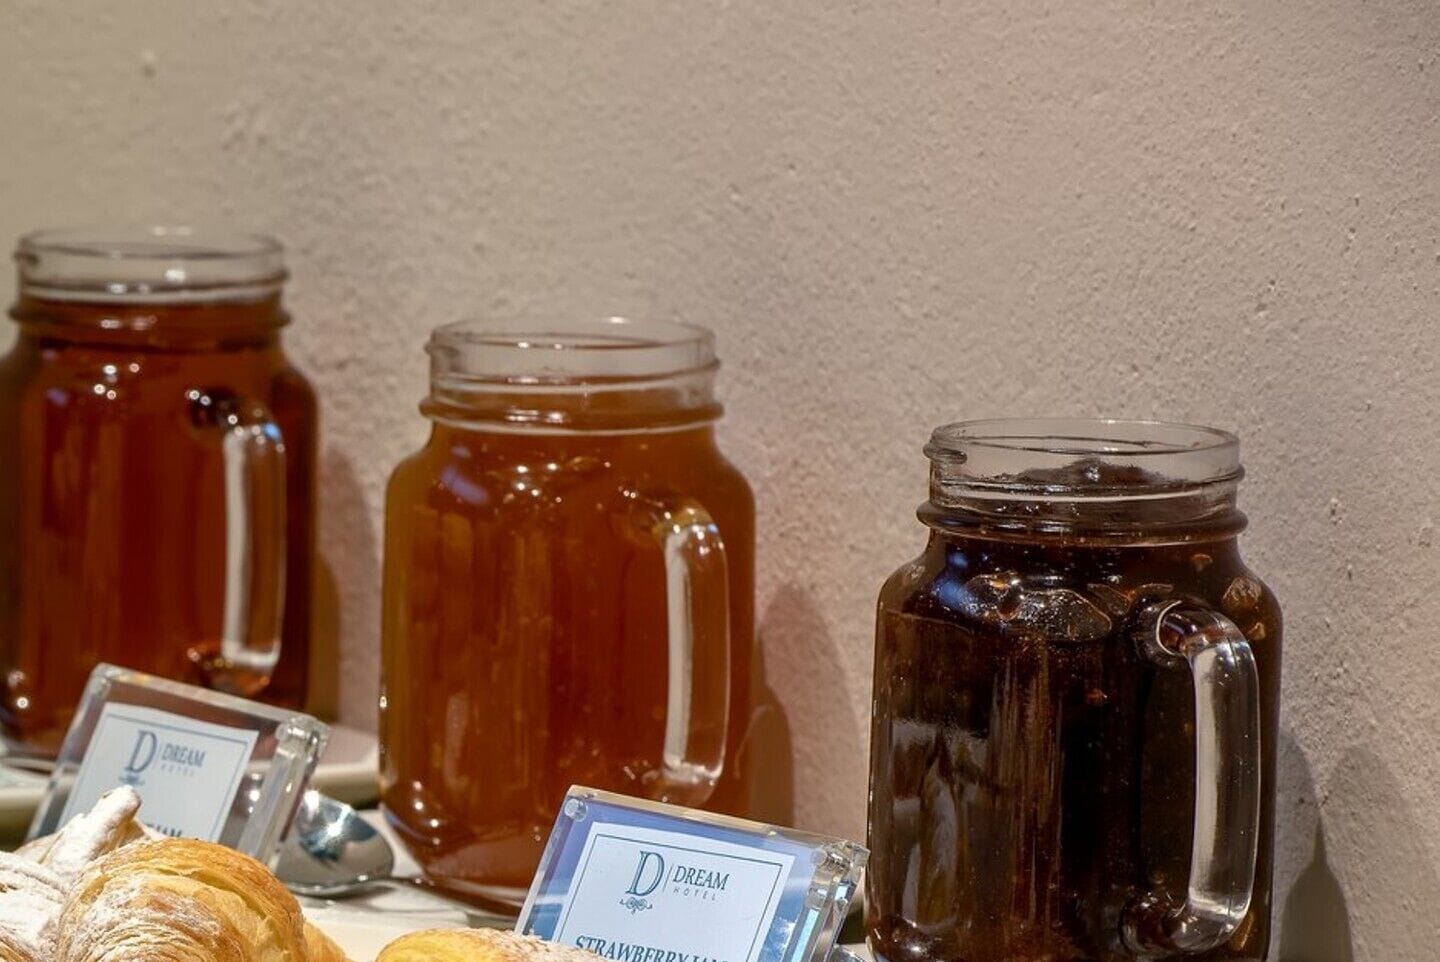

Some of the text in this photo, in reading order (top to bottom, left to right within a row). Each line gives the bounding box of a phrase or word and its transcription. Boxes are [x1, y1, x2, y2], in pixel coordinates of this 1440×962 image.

[124, 730, 206, 773] D DREAM
[625, 850, 730, 896] D DREAM
[673, 887, 716, 901] HOTEL
